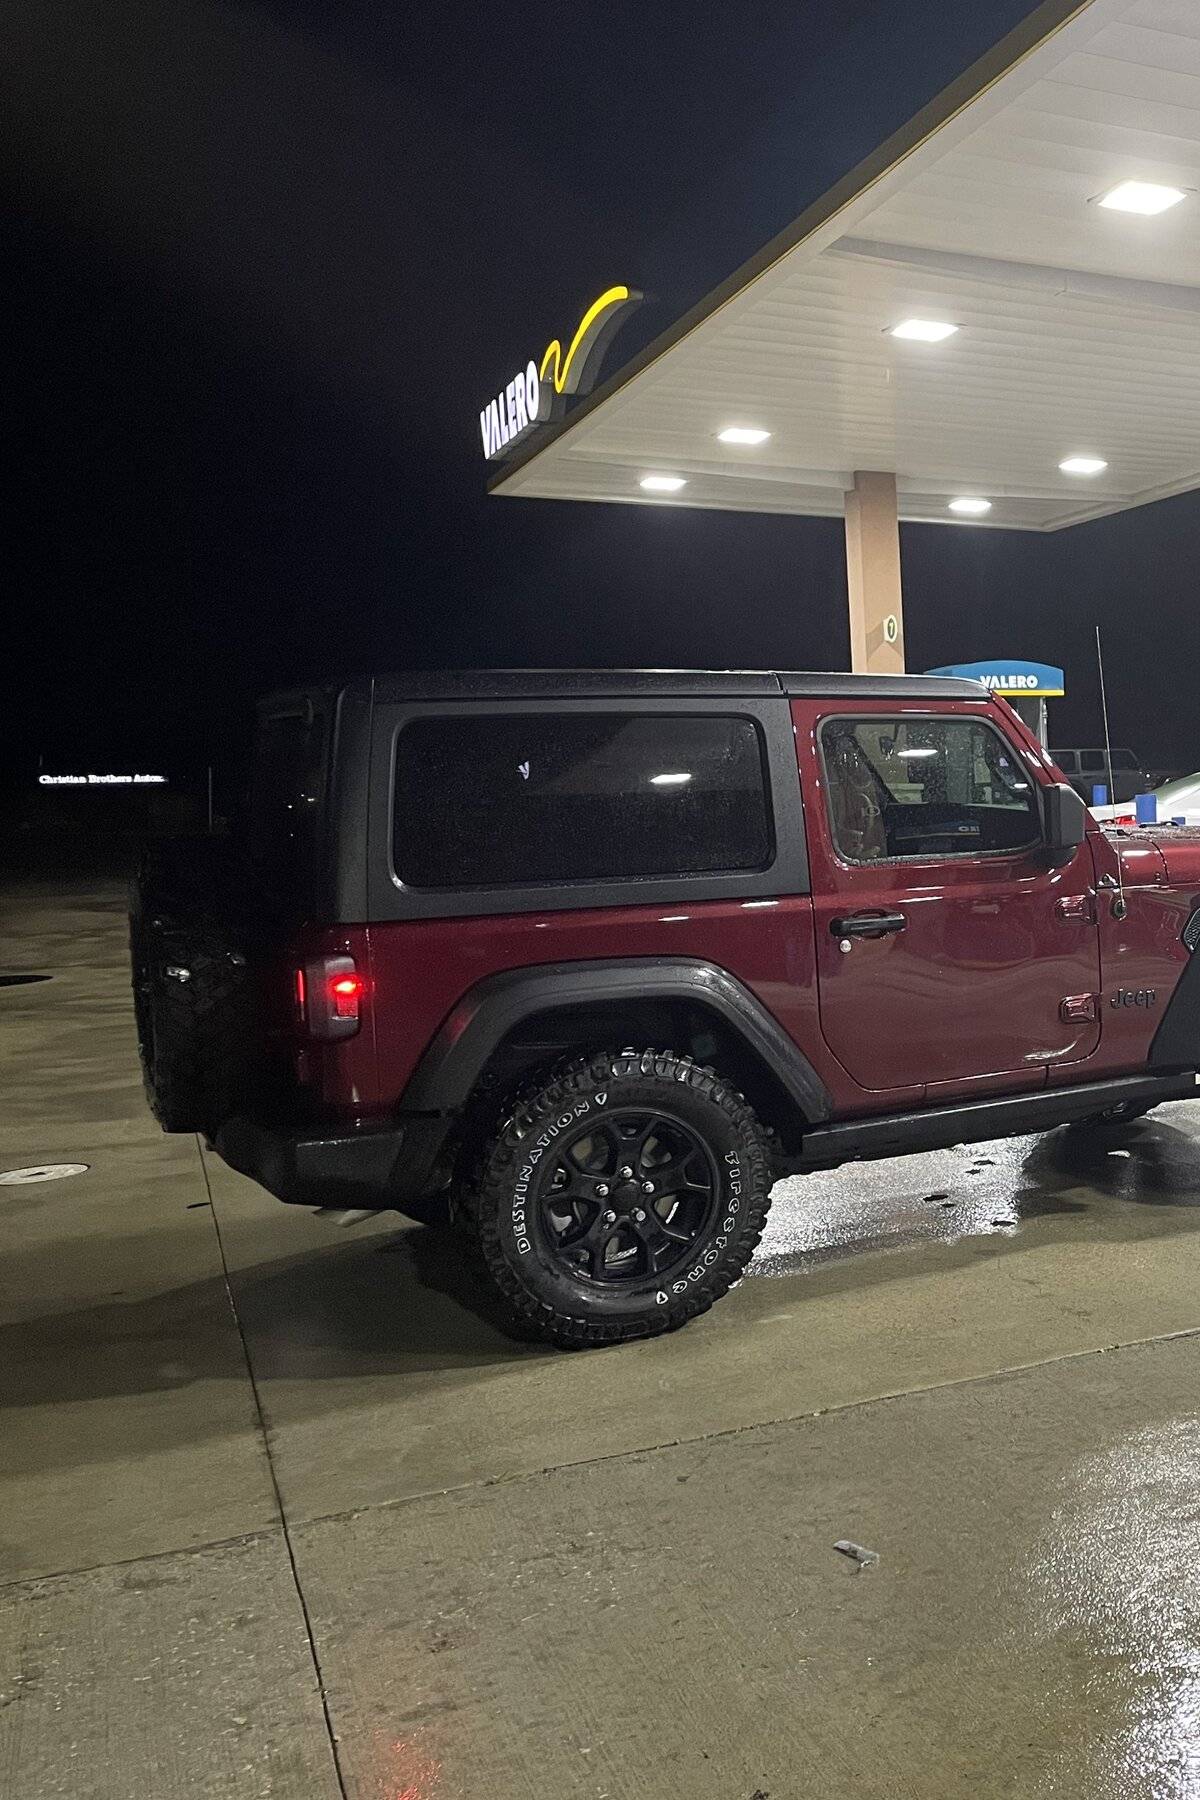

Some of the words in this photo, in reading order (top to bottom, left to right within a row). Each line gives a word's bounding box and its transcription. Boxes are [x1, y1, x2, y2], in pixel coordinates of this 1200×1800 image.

[480, 360, 539, 460] VALERO
[980, 675, 1039, 689] VALERO
[39, 775, 87, 784] Christian
[88, 774, 132, 783] Brothers
[1110, 988, 1156, 1009] Jeep
[512, 1100, 590, 1254] DESTINATION
